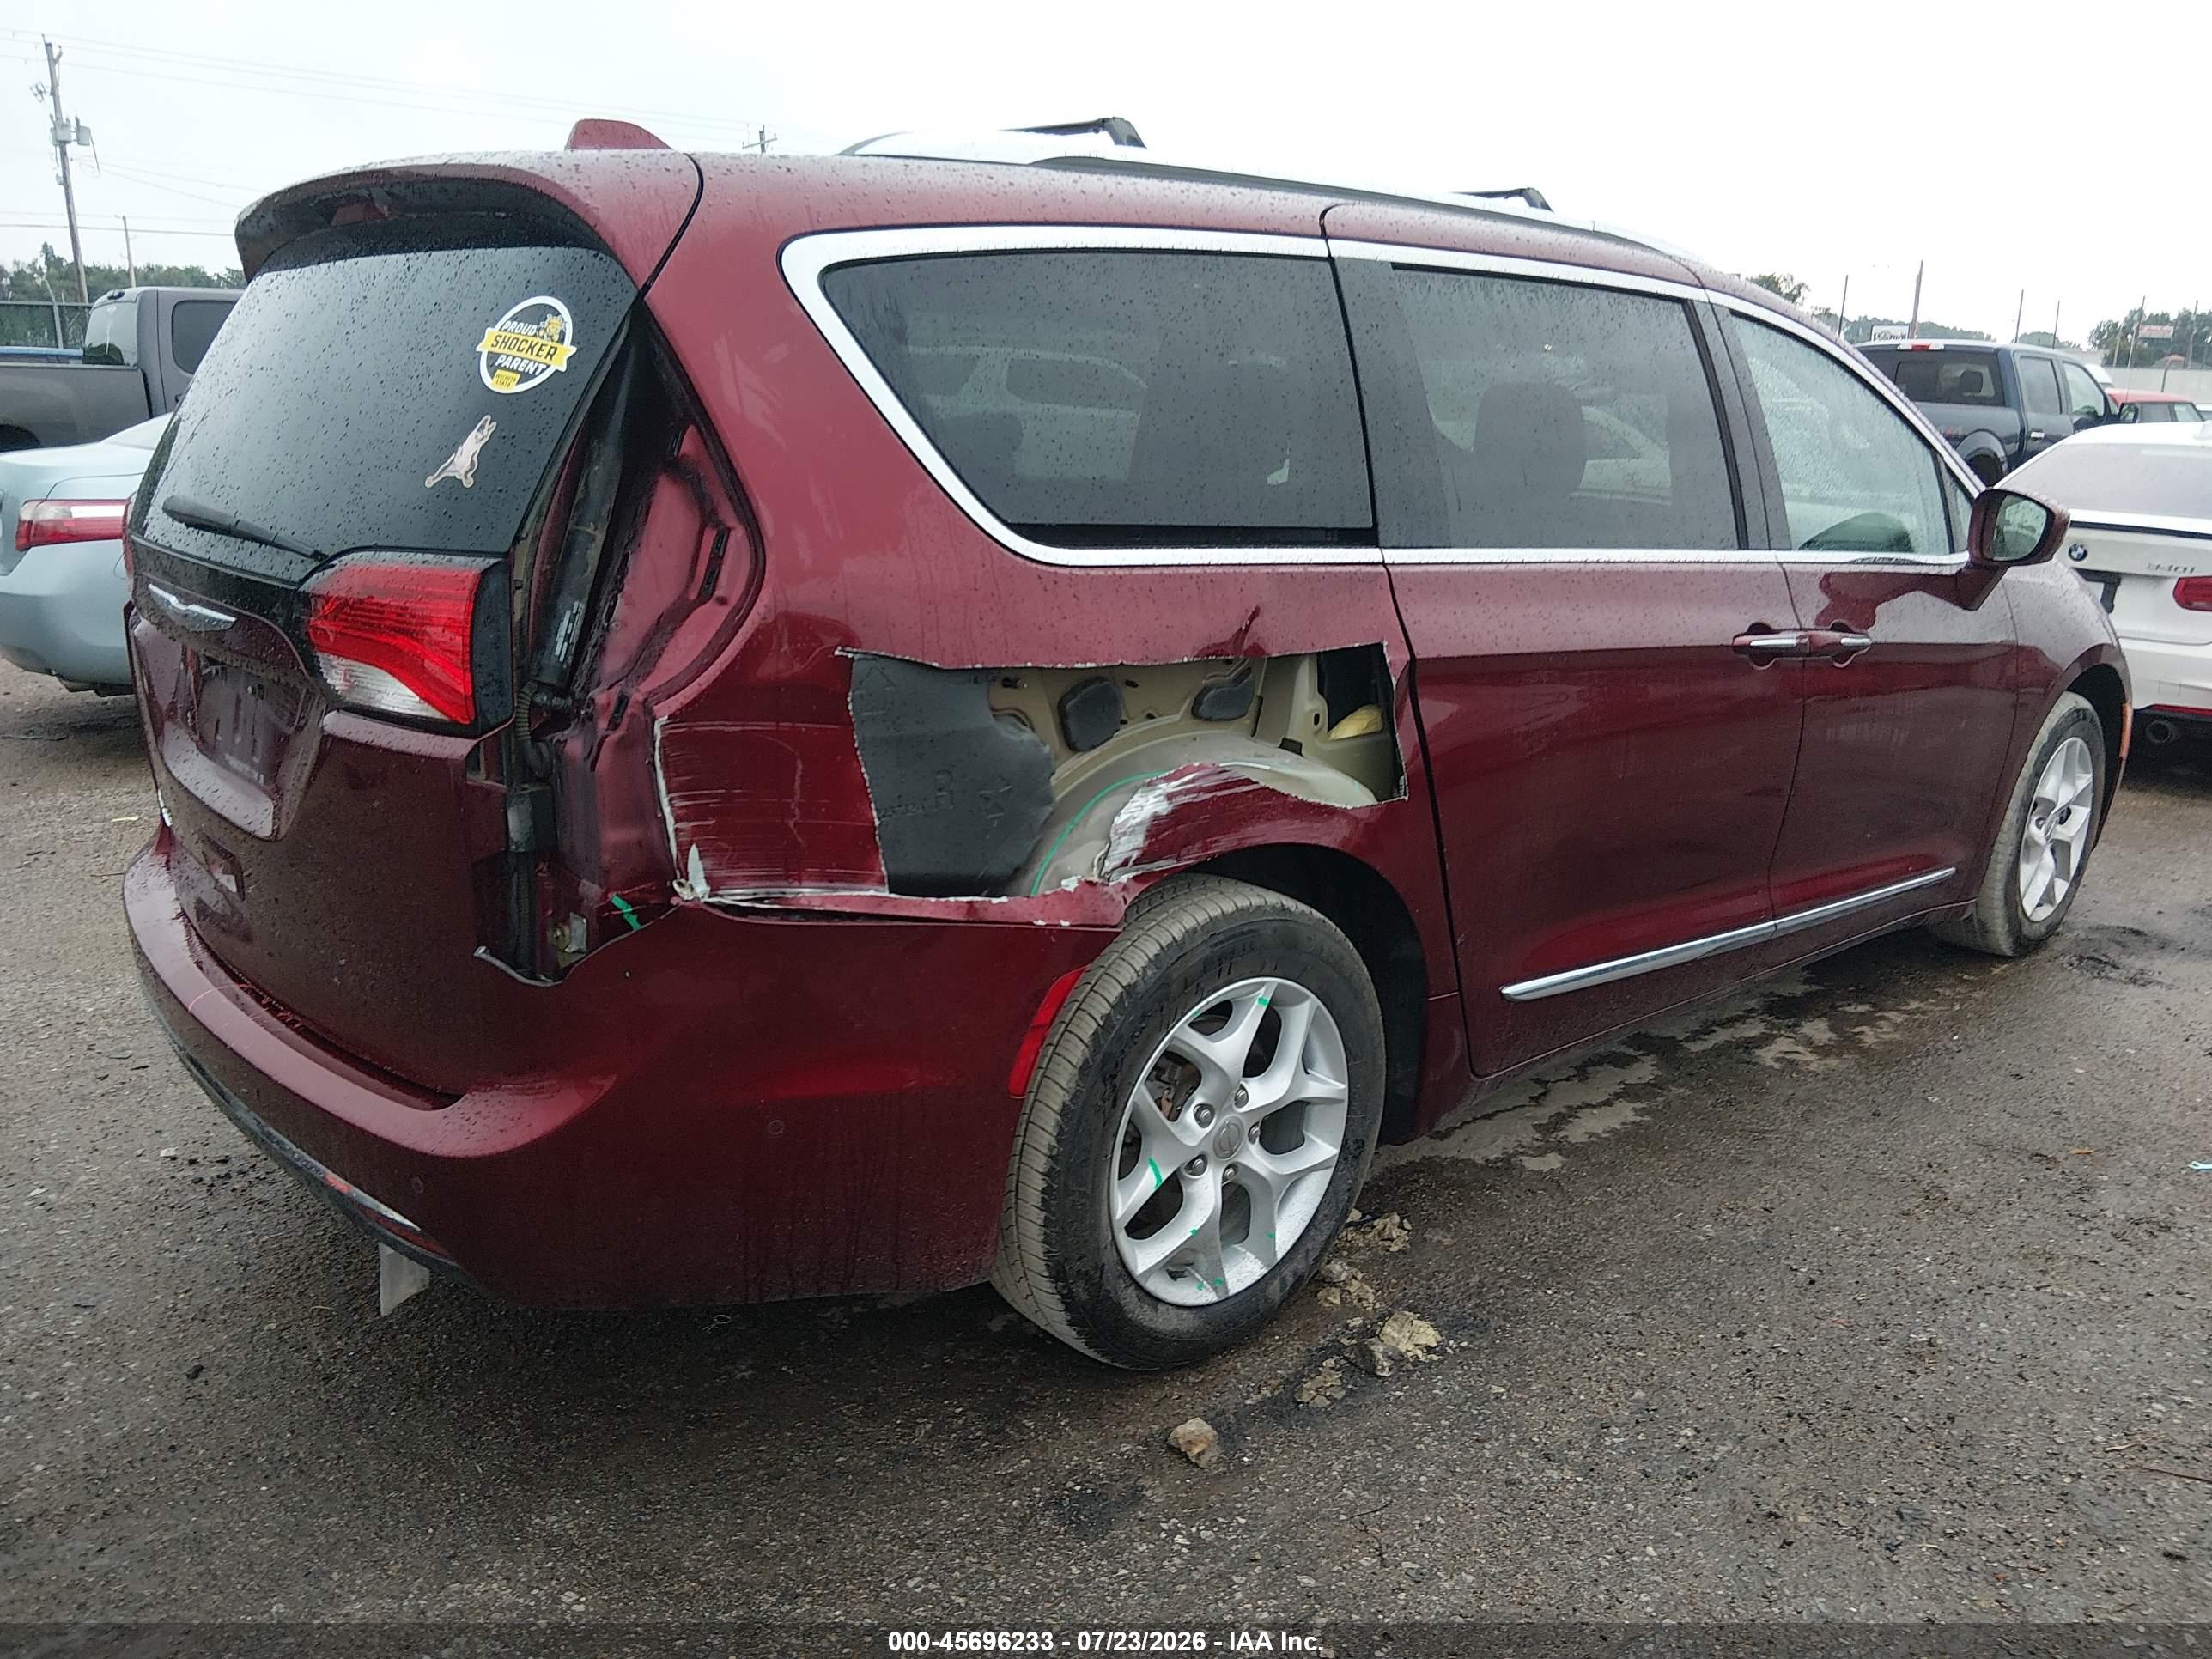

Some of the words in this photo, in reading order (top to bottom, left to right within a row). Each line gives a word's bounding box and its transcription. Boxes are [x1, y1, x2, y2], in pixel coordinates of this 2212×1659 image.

[501, 320, 538, 336] PROUD
[490, 334, 558, 361] SHOCKER
[495, 354, 547, 375] PARENT
